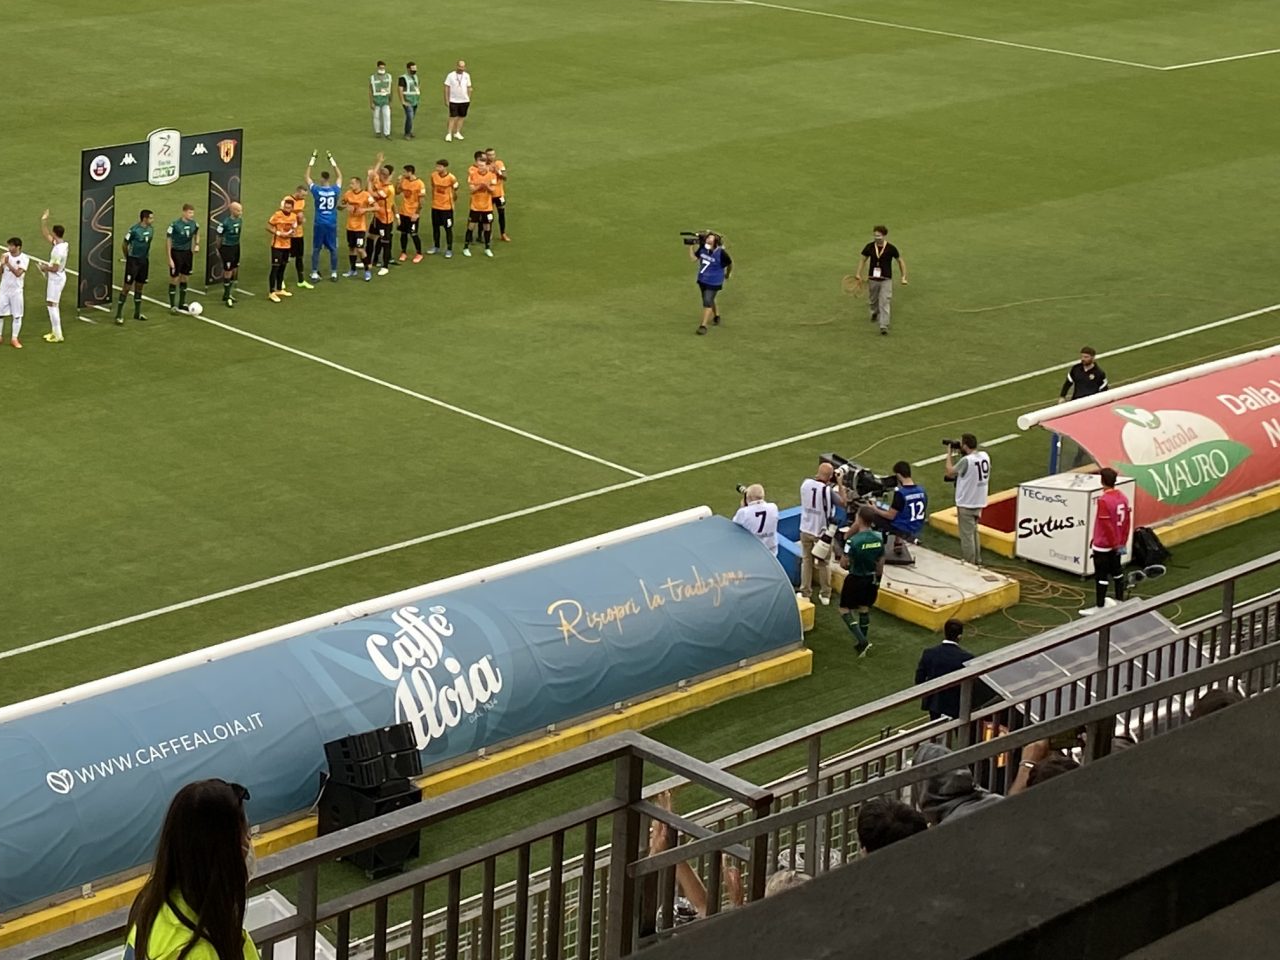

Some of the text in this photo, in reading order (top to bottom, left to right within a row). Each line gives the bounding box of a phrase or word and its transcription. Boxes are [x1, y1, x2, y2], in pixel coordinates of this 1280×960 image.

[319, 196, 335, 210] 29
[699, 259, 711, 274] 7
[975, 459, 990, 480] 19
[1147, 448, 1229, 501] MAURO
[754, 510, 767, 533] 7
[909, 501, 925, 521] 12
[639, 578, 665, 611] la
[74, 712, 265, 784] WWW.CAFFEALOIA.IT
